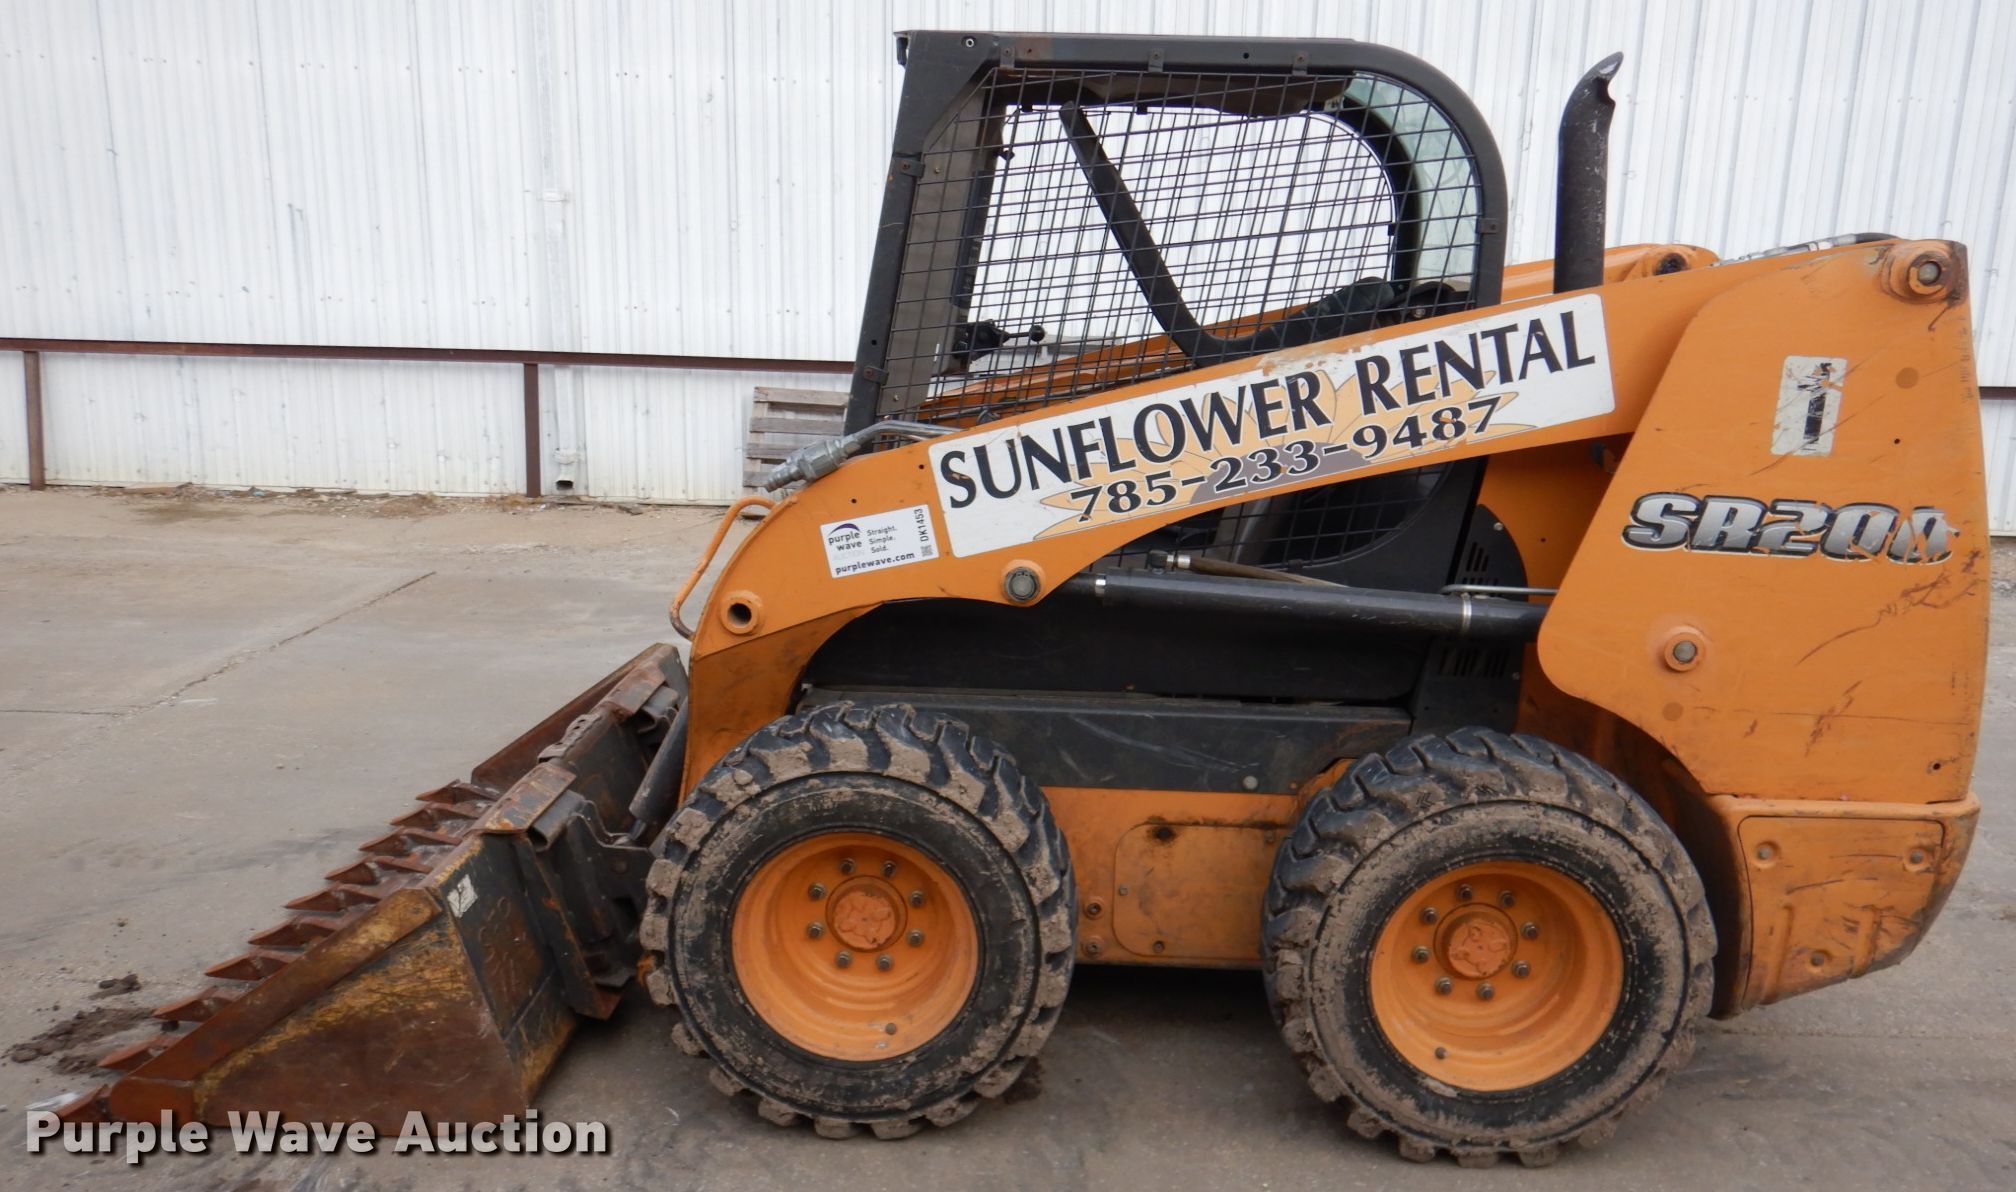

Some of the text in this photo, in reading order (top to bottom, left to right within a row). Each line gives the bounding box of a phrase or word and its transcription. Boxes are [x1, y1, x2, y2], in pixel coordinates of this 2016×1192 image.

[941, 311, 1597, 509] SUNFLOWER RENTAL
[1070, 395, 1504, 523] 785-233-9487
[866, 525, 898, 537] Straight.
[914, 508, 929, 542] DK1453
[828, 531, 861, 546] purple
[836, 540, 862, 552] wave
[868, 535, 896, 545] Simple.
[835, 552, 915, 575] purplewave.com
